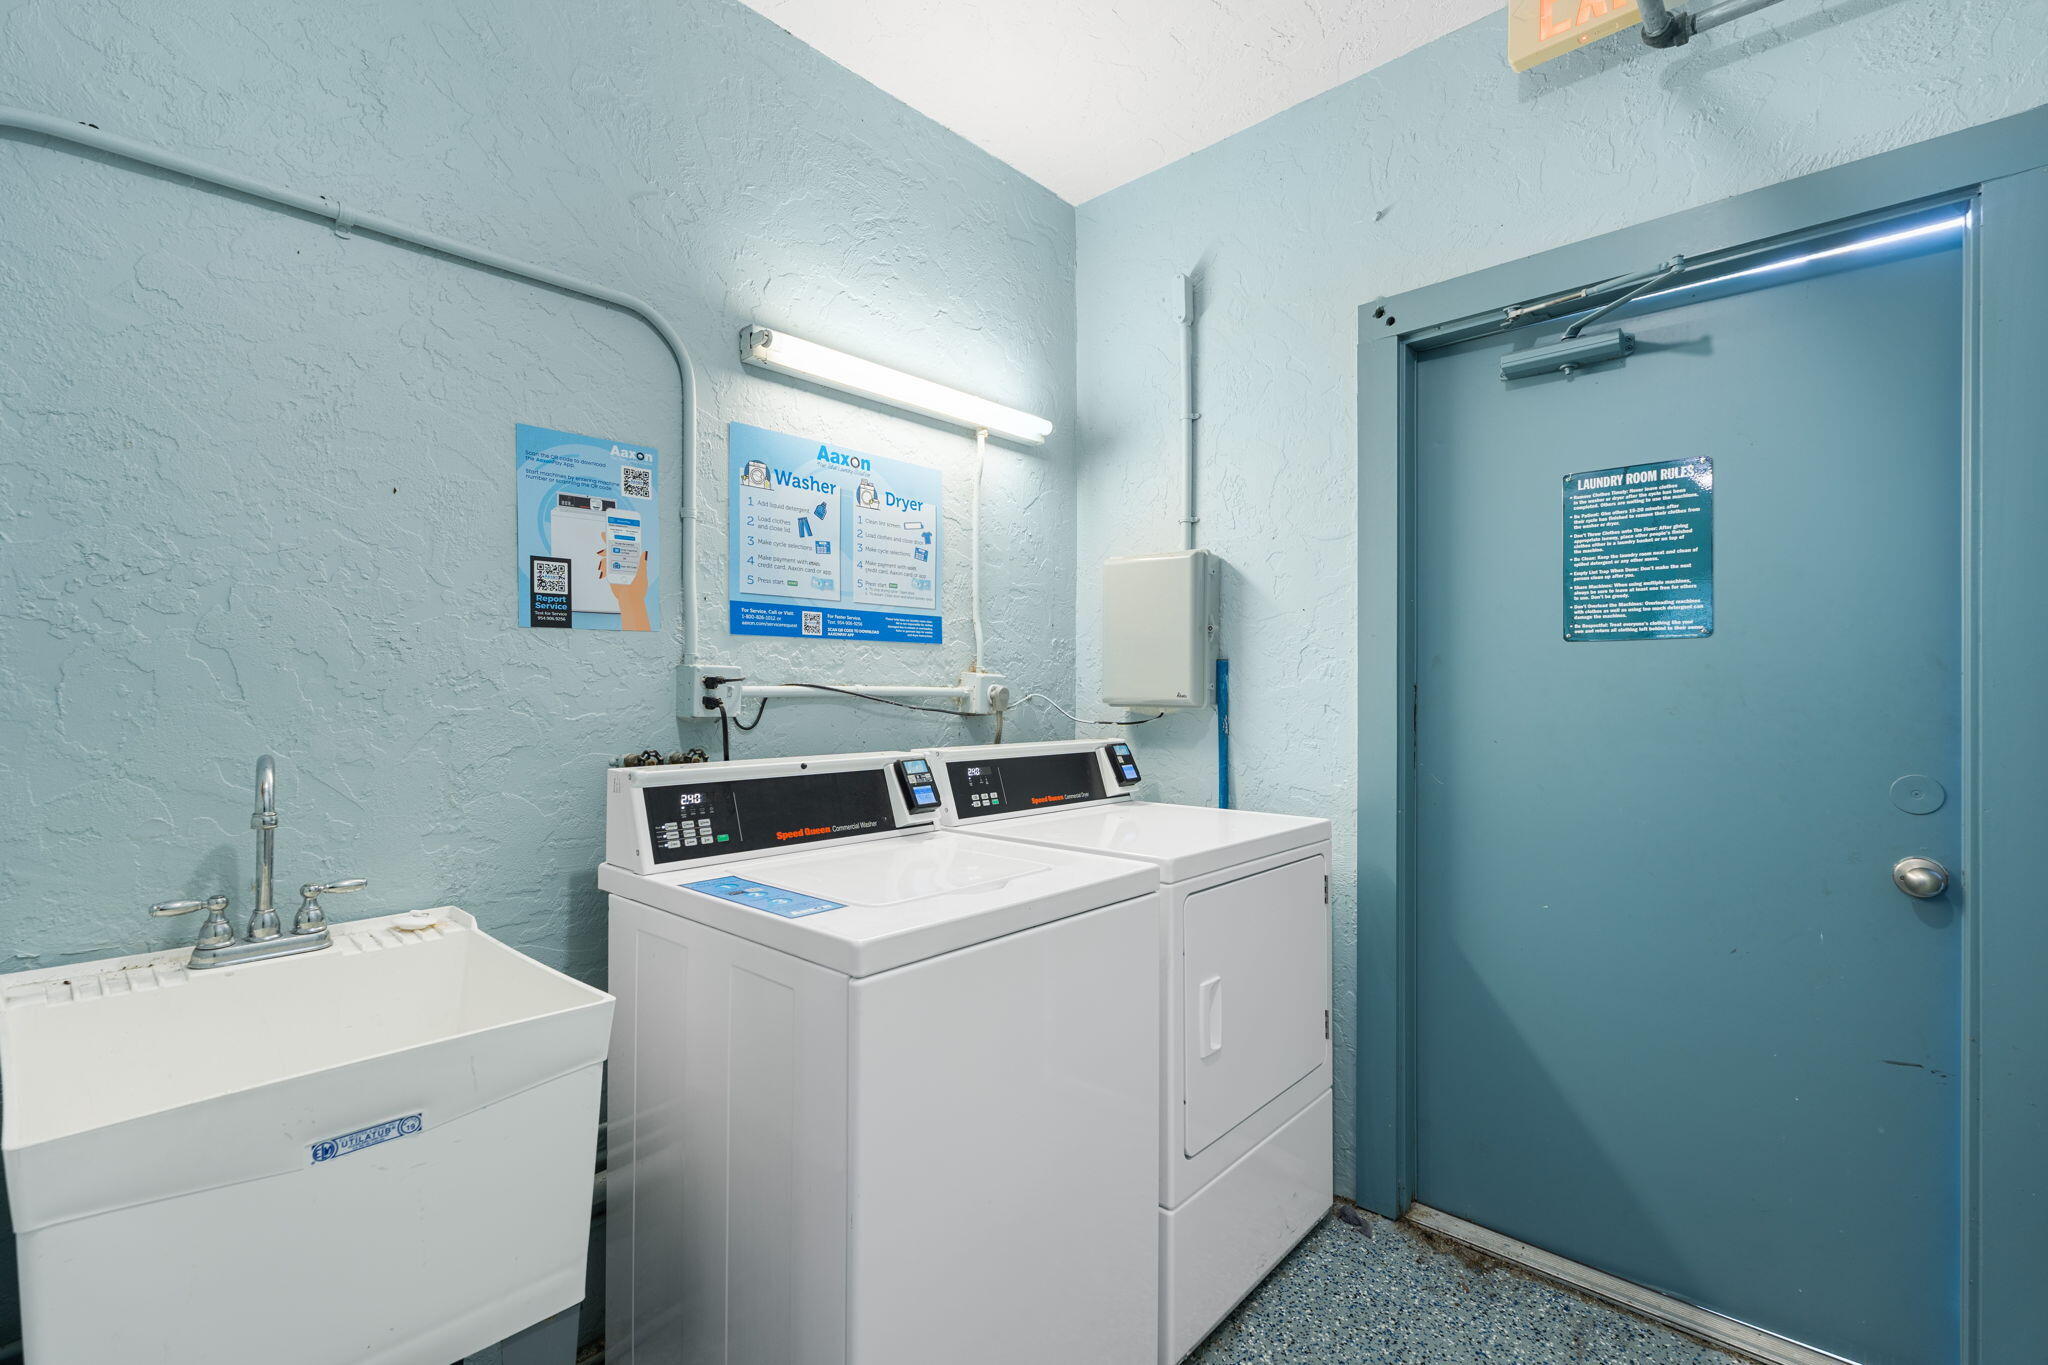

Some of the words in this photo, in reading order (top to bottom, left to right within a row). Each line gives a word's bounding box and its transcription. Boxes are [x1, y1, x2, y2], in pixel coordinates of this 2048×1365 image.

[609, 445, 652, 462] Aaxon
[816, 443, 870, 471] Aaxon
[773, 468, 836, 495] Washer
[1577, 475, 1623, 490] LAUNDRY
[1626, 469, 1657, 484] ROOM
[1660, 464, 1694, 480] RULES
[748, 496, 753, 506] 1
[885, 491, 922, 515] Dryer
[747, 515, 754, 526] 2
[857, 515, 861, 524] 1
[856, 528, 862, 538] 2
[747, 535, 754, 545] 3
[857, 542, 862, 552] 3
[747, 555, 754, 564] 4
[747, 575, 753, 584] 5
[857, 578, 862, 587] 5
[536, 594, 566, 603] Report
[1032, 796, 1048, 805] Speed
[776, 828, 804, 840] Speed
[804, 826, 831, 836] Queen
[832, 822, 860, 832] Commercial
[860, 821, 878, 829] Washer
